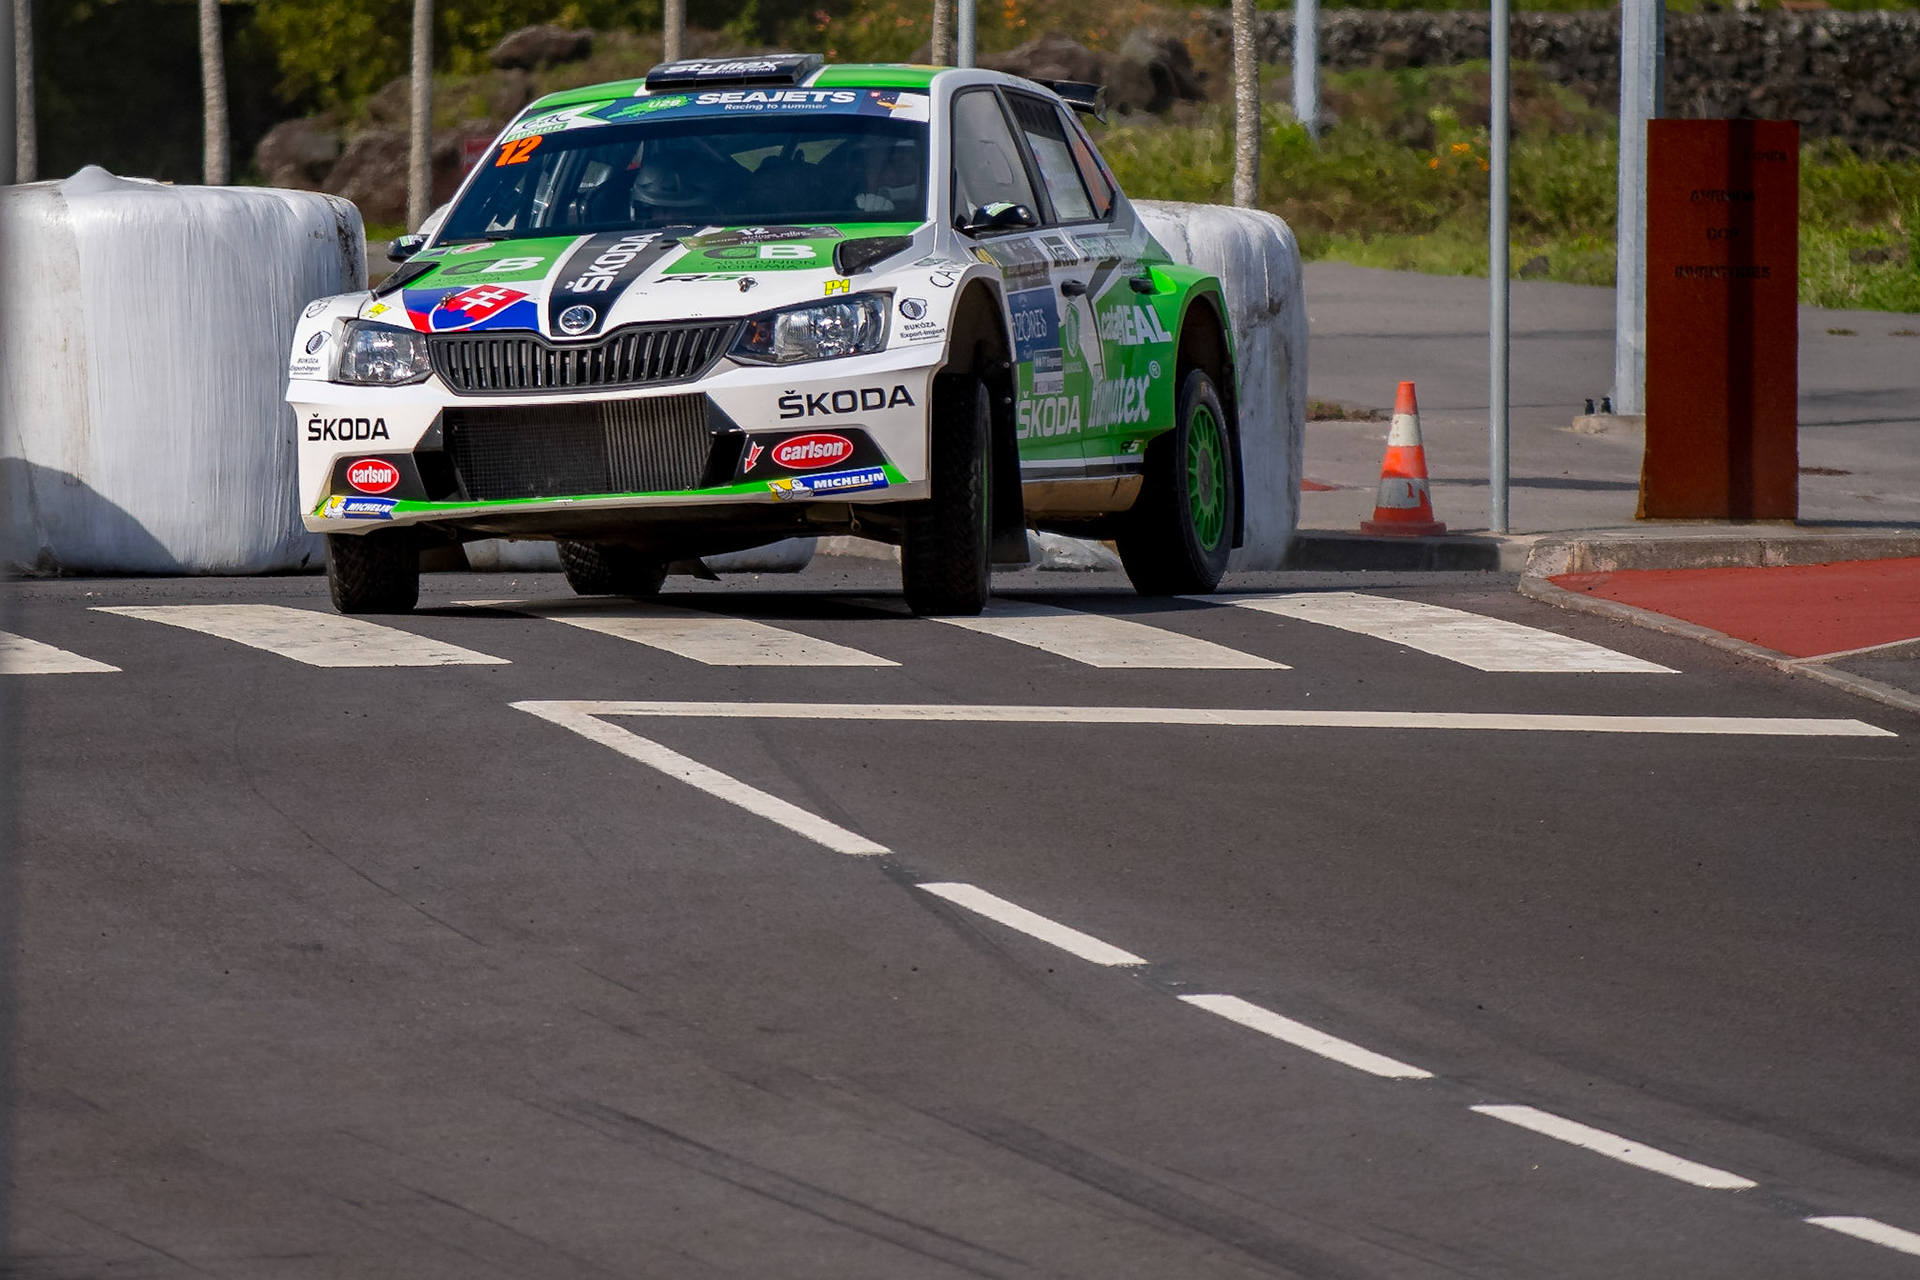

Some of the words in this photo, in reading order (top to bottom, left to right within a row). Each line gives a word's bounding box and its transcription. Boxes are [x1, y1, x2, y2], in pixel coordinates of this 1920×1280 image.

[695, 91, 857, 105] SEAJETS
[724, 104, 764, 112] Racing
[508, 124, 565, 142] JUNIOR
[495, 136, 543, 167] 12
[736, 227, 769, 236] 12
[565, 232, 662, 292] ŠKODA
[1675, 266, 1771, 279] INVENTORES
[824, 279, 851, 296] P1
[900, 328, 945, 339] Export-Import
[778, 385, 915, 419] ŠKODA
[1016, 391, 1081, 440] ŠKODA
[308, 413, 390, 441] ŠKODA
[780, 440, 843, 461] carlson
[352, 465, 392, 484] carlson
[813, 472, 885, 489] MICHELIN
[347, 502, 393, 513] MICHELIN
